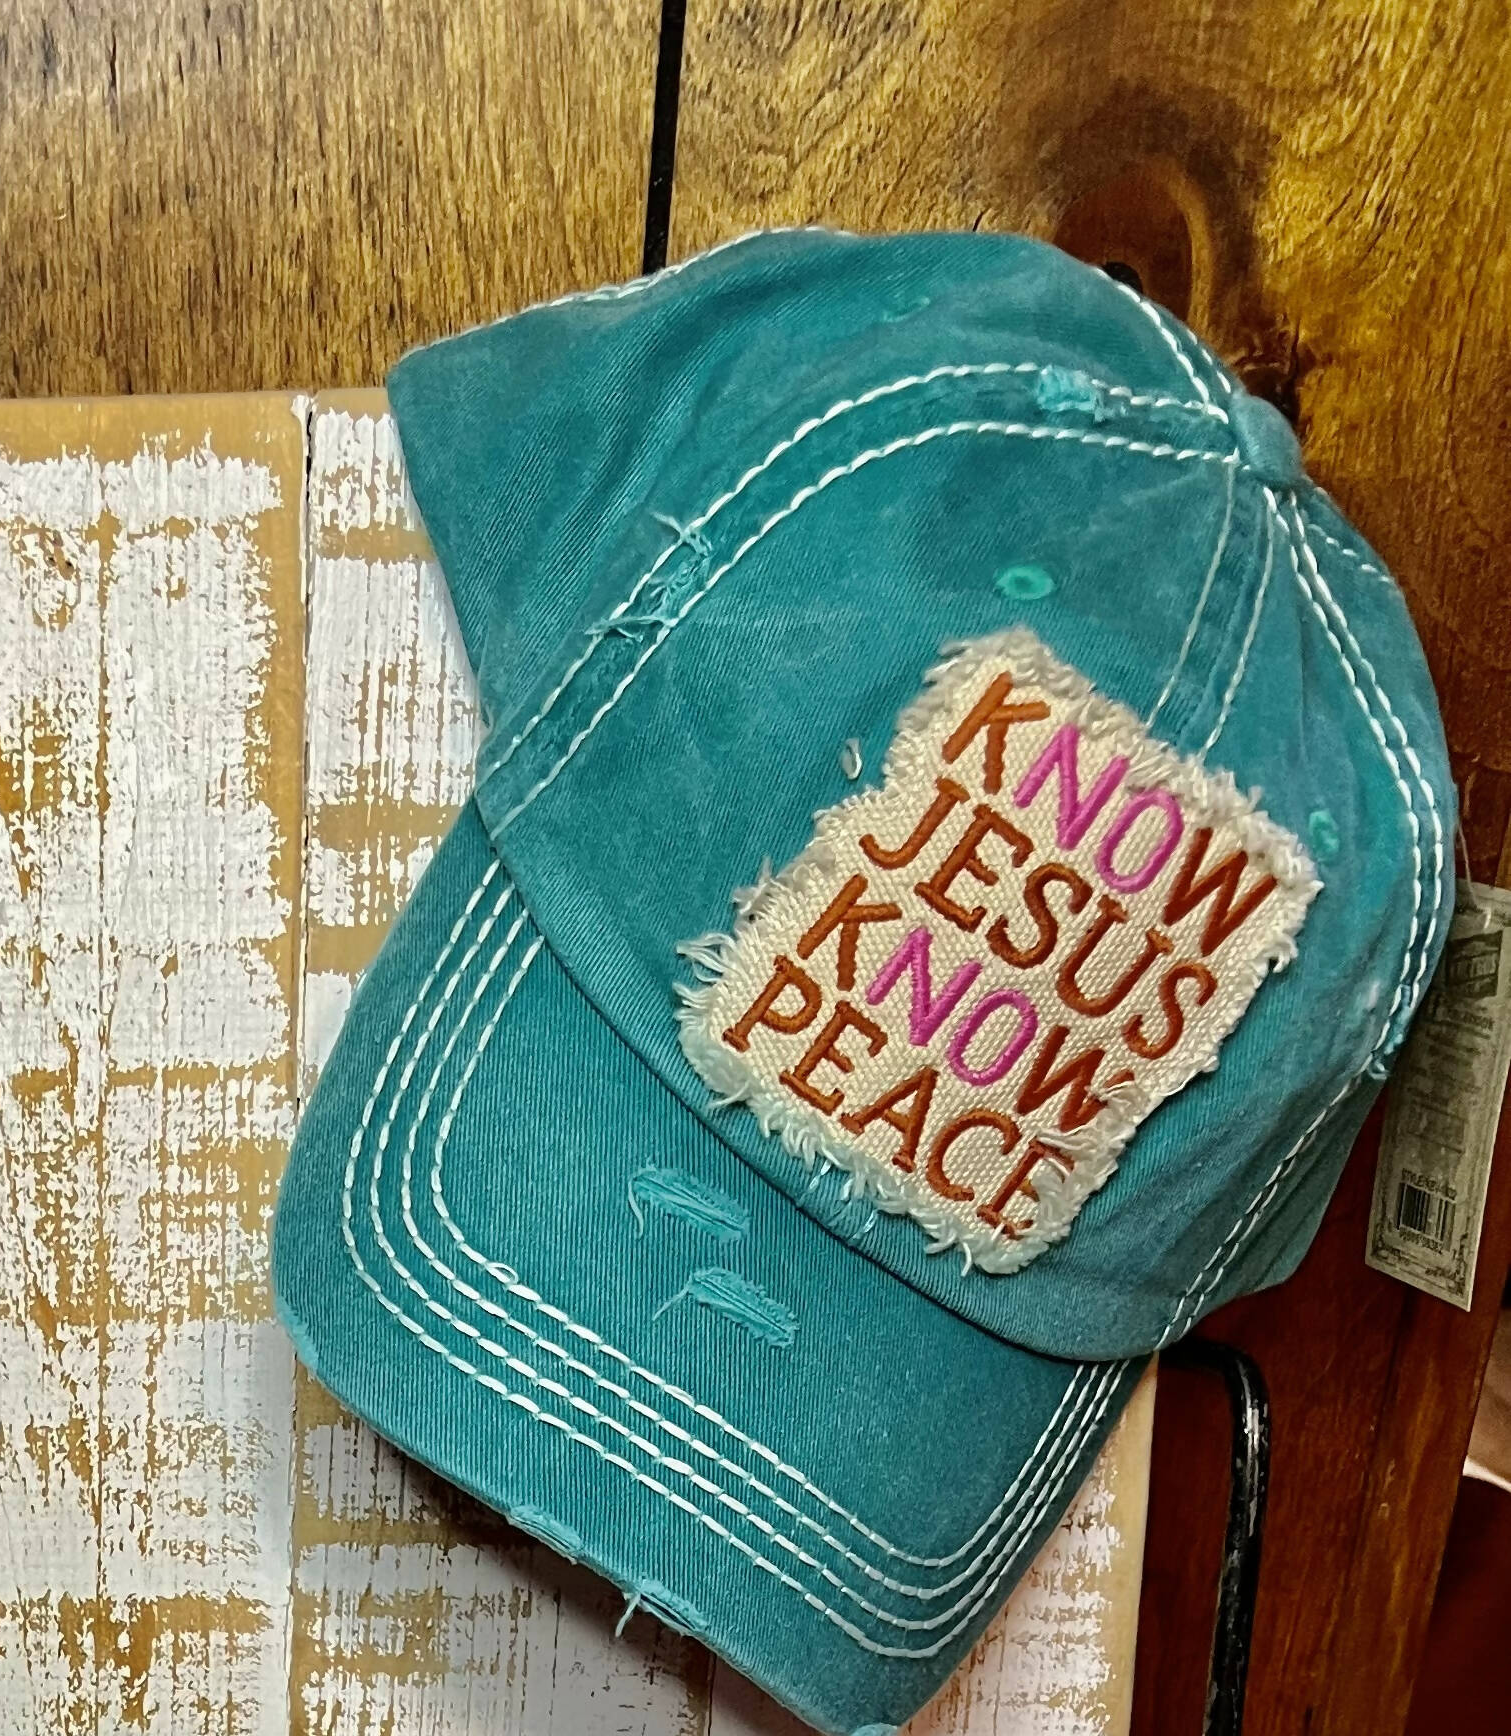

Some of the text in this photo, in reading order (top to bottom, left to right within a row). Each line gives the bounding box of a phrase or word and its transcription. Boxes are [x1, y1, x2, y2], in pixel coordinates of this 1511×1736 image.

[859, 776, 1218, 1060] JESUS
[942, 670, 1277, 957] KNOW
[722, 955, 1076, 1241] PEACE
[797, 873, 1135, 1133] KNOW
